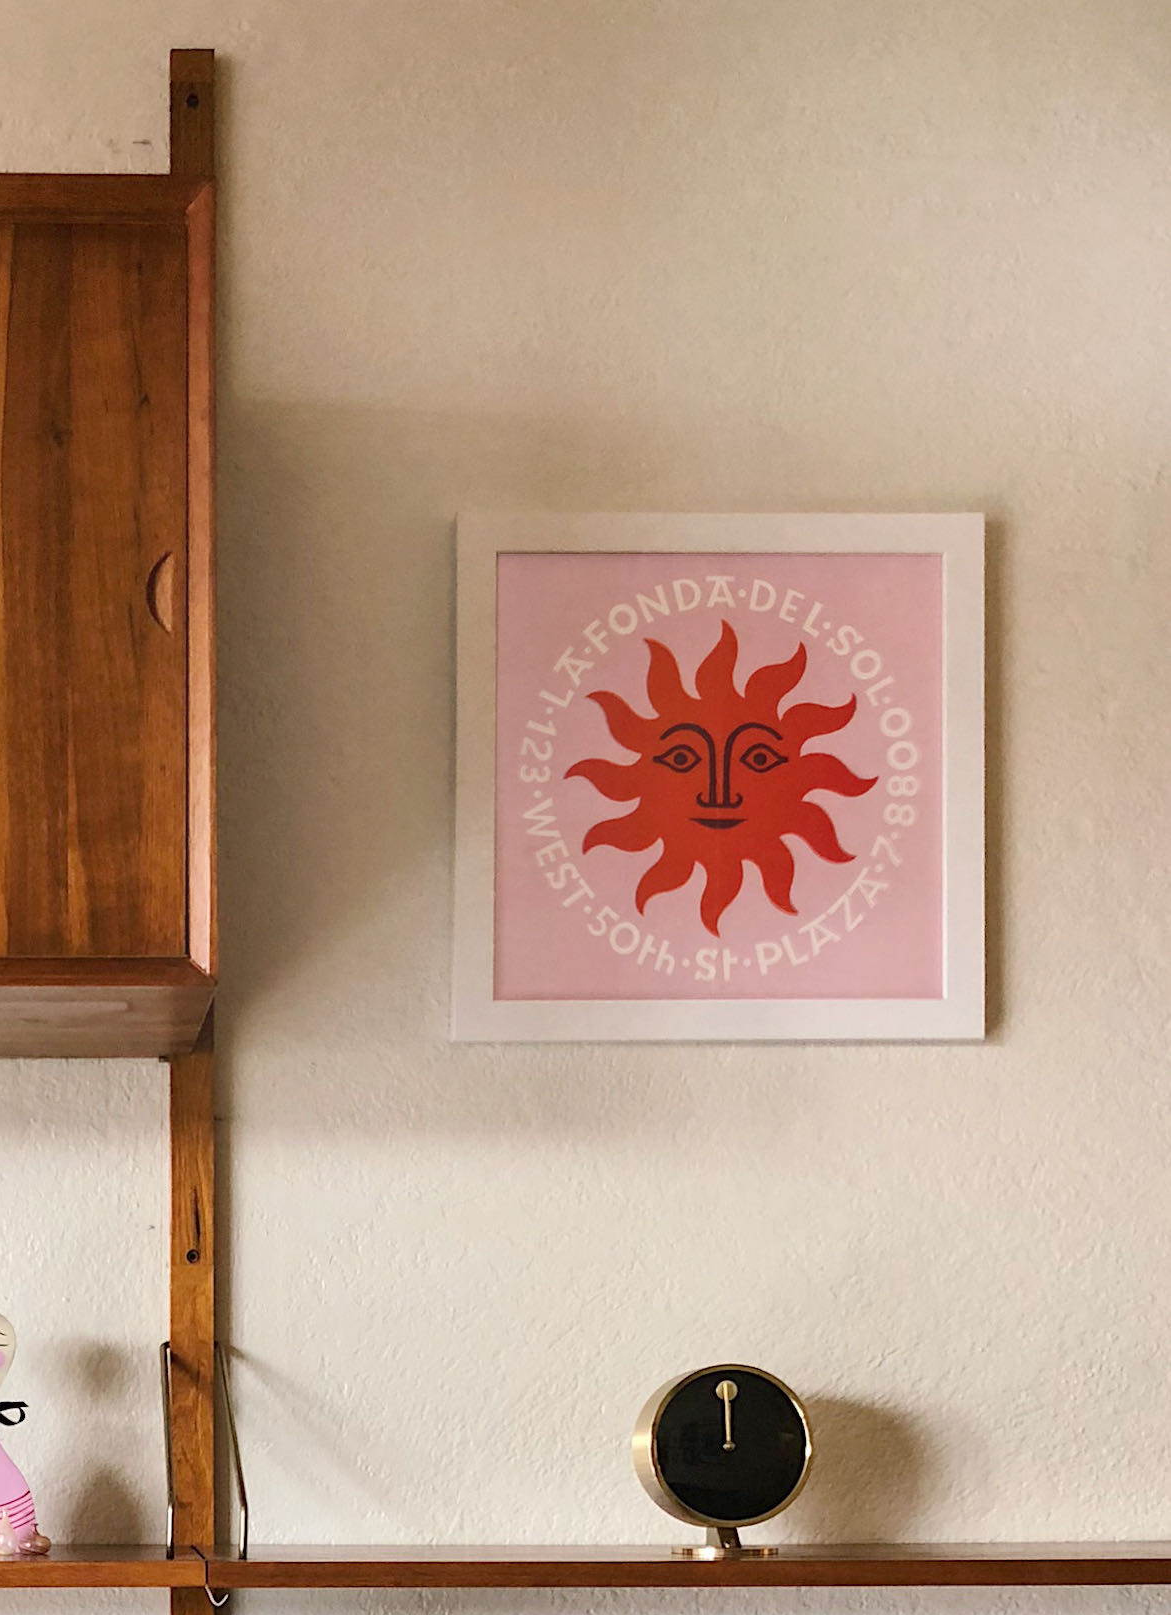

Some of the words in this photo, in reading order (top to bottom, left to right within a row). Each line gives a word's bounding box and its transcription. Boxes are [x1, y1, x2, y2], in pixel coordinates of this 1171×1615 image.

[538, 646, 595, 709] LA
[582, 574, 736, 655] FONDA
[748, 578, 825, 638] DEL
[825, 624, 895, 706] SOL
[519, 719, 558, 783] 123
[521, 797, 595, 911] WEST
[588, 905, 676, 977] 50th
[694, 948, 737, 982] St
[755, 866, 889, 976] PLAZA
